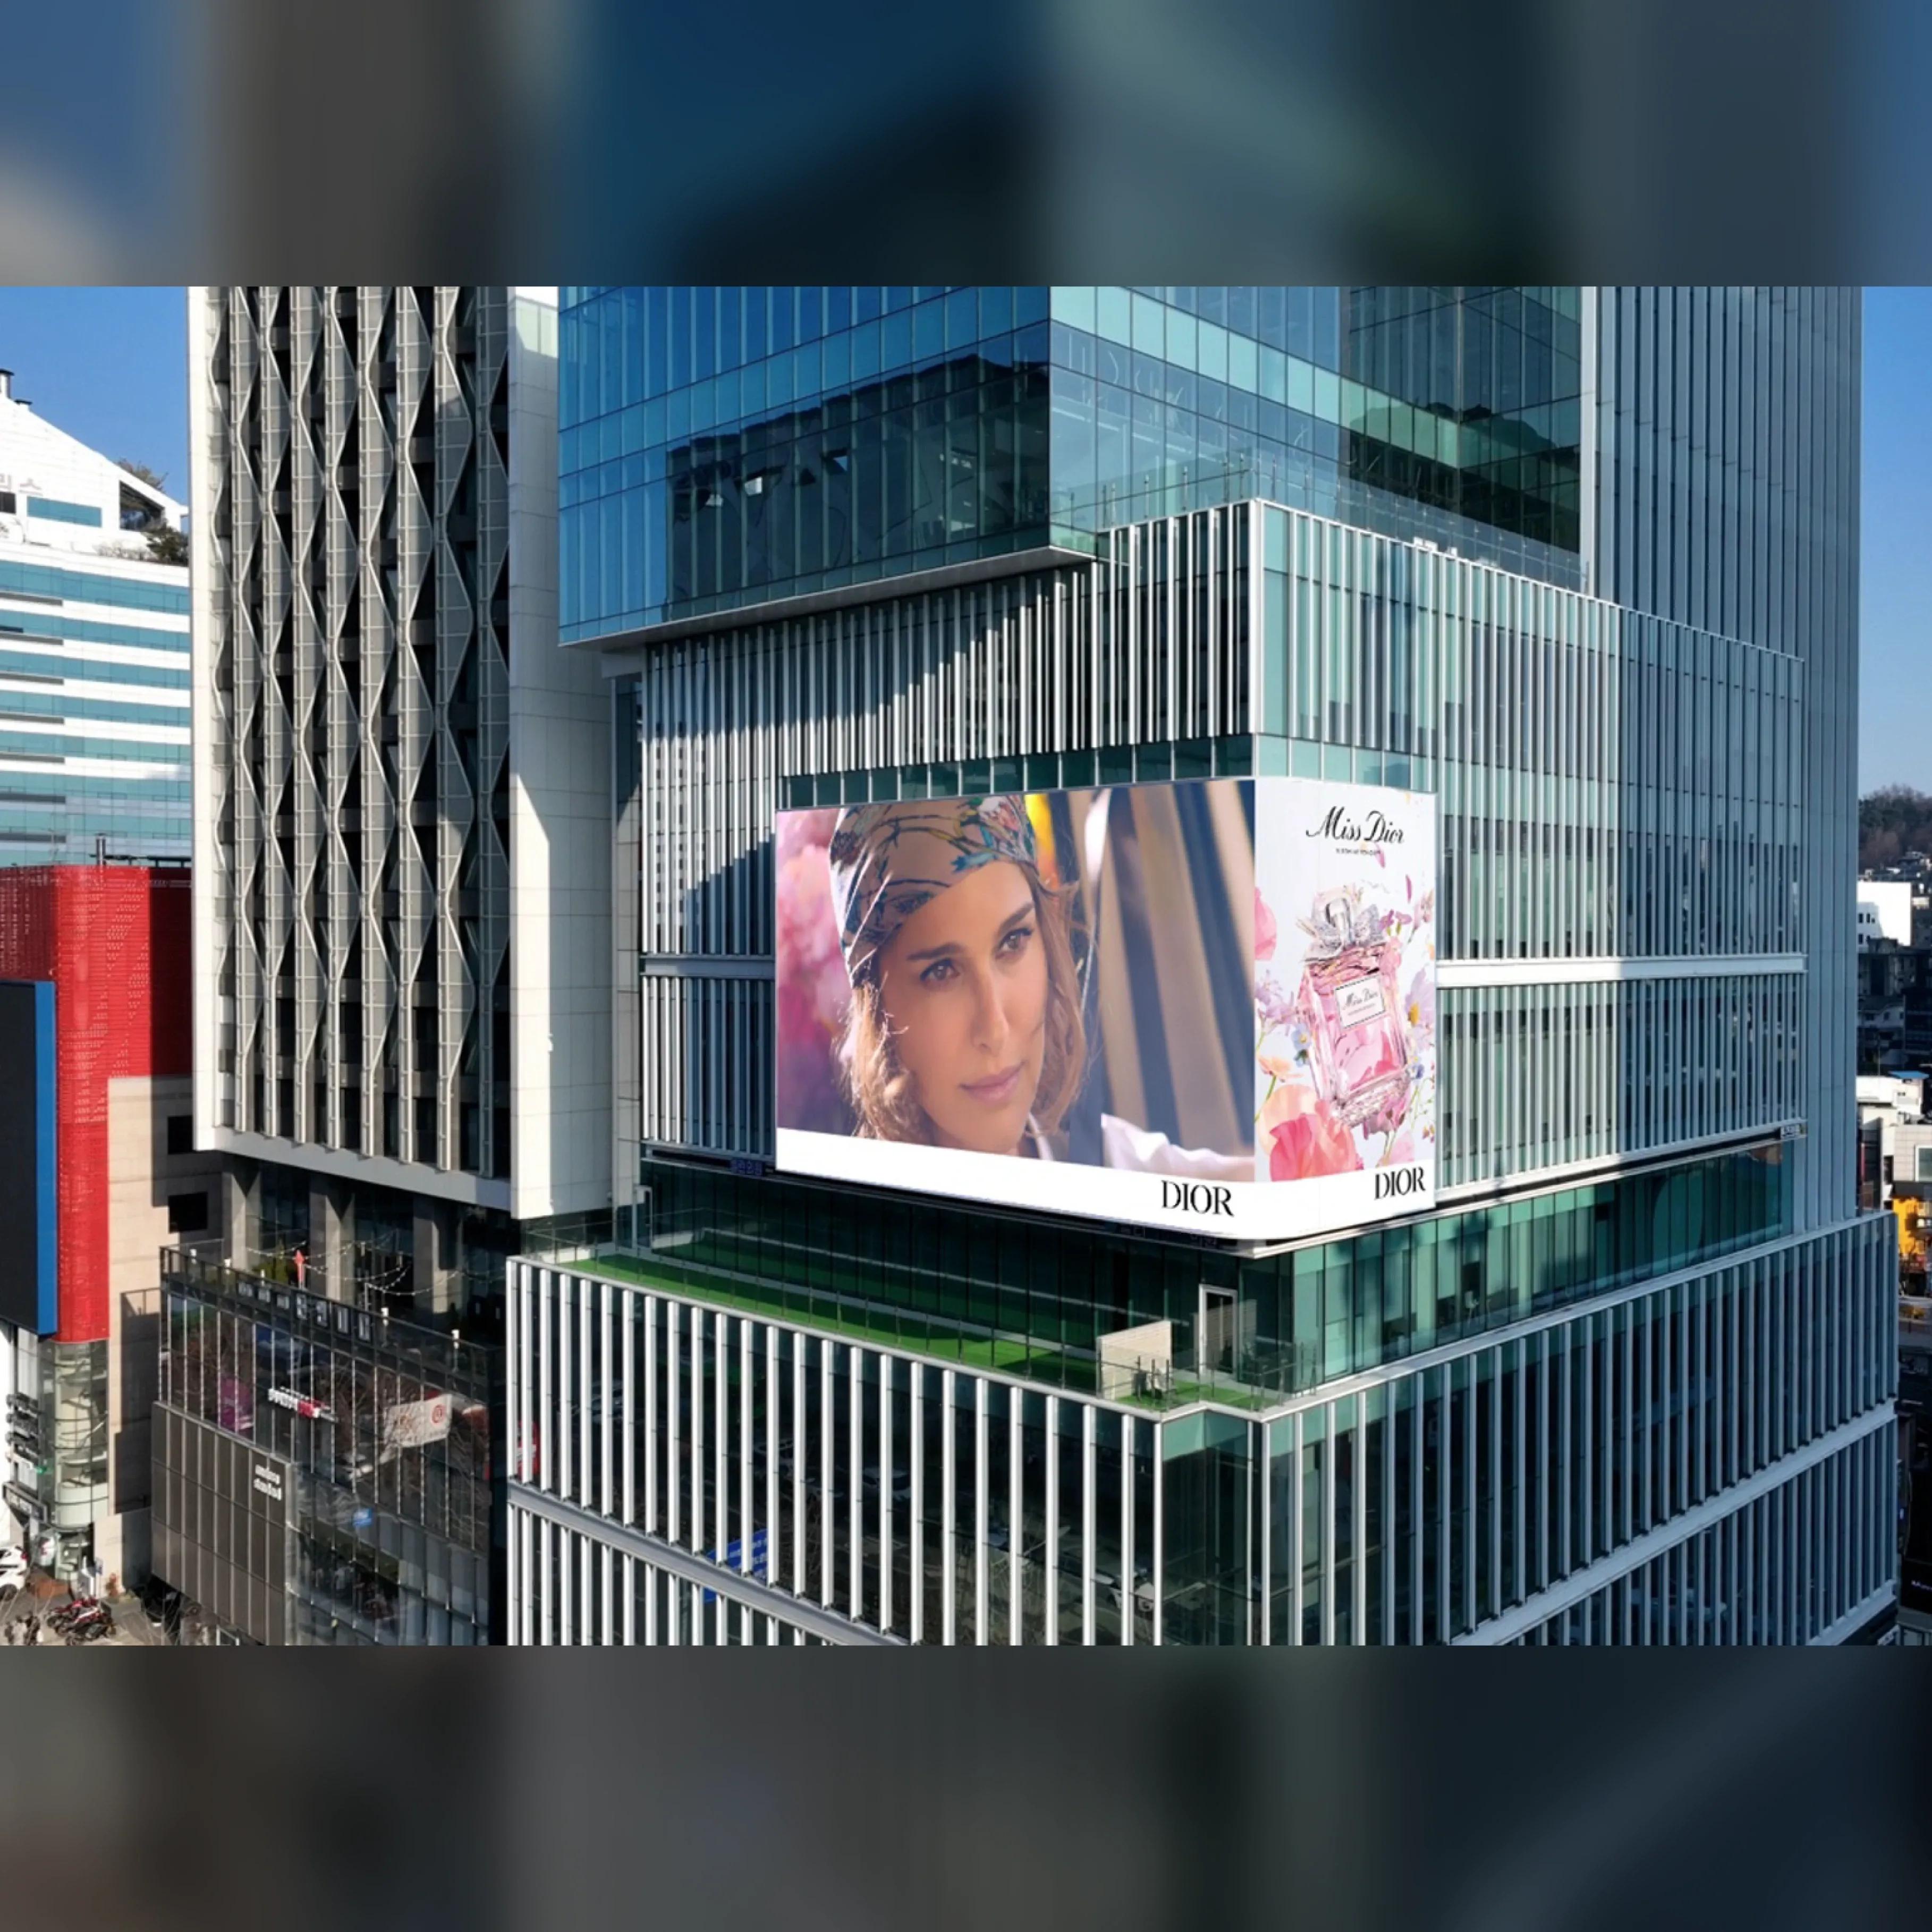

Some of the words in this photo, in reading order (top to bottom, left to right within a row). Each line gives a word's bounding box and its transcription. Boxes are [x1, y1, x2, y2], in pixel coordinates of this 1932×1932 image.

[1306, 806, 1361, 842] Miss
[1363, 810, 1404, 843] Dior
[1161, 1180, 1235, 1217] DIOR
[1374, 1166, 1426, 1200] DIOR
